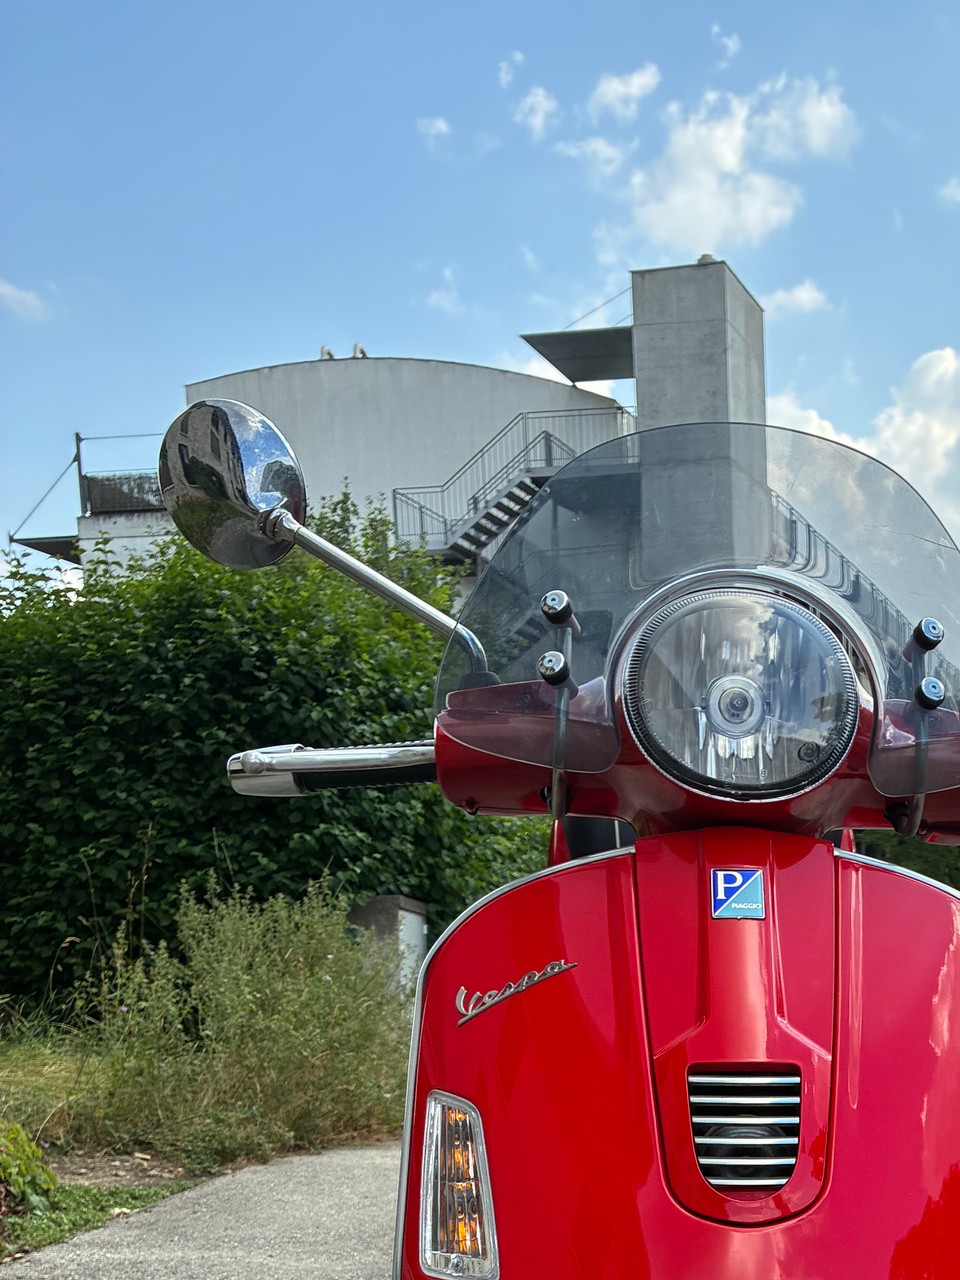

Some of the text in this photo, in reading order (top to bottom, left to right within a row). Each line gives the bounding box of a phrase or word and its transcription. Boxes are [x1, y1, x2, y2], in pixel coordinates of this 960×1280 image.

[716, 871, 743, 900] P
[731, 902, 763, 910] PIAGGIO
[455, 959, 578, 1027] Vespa
